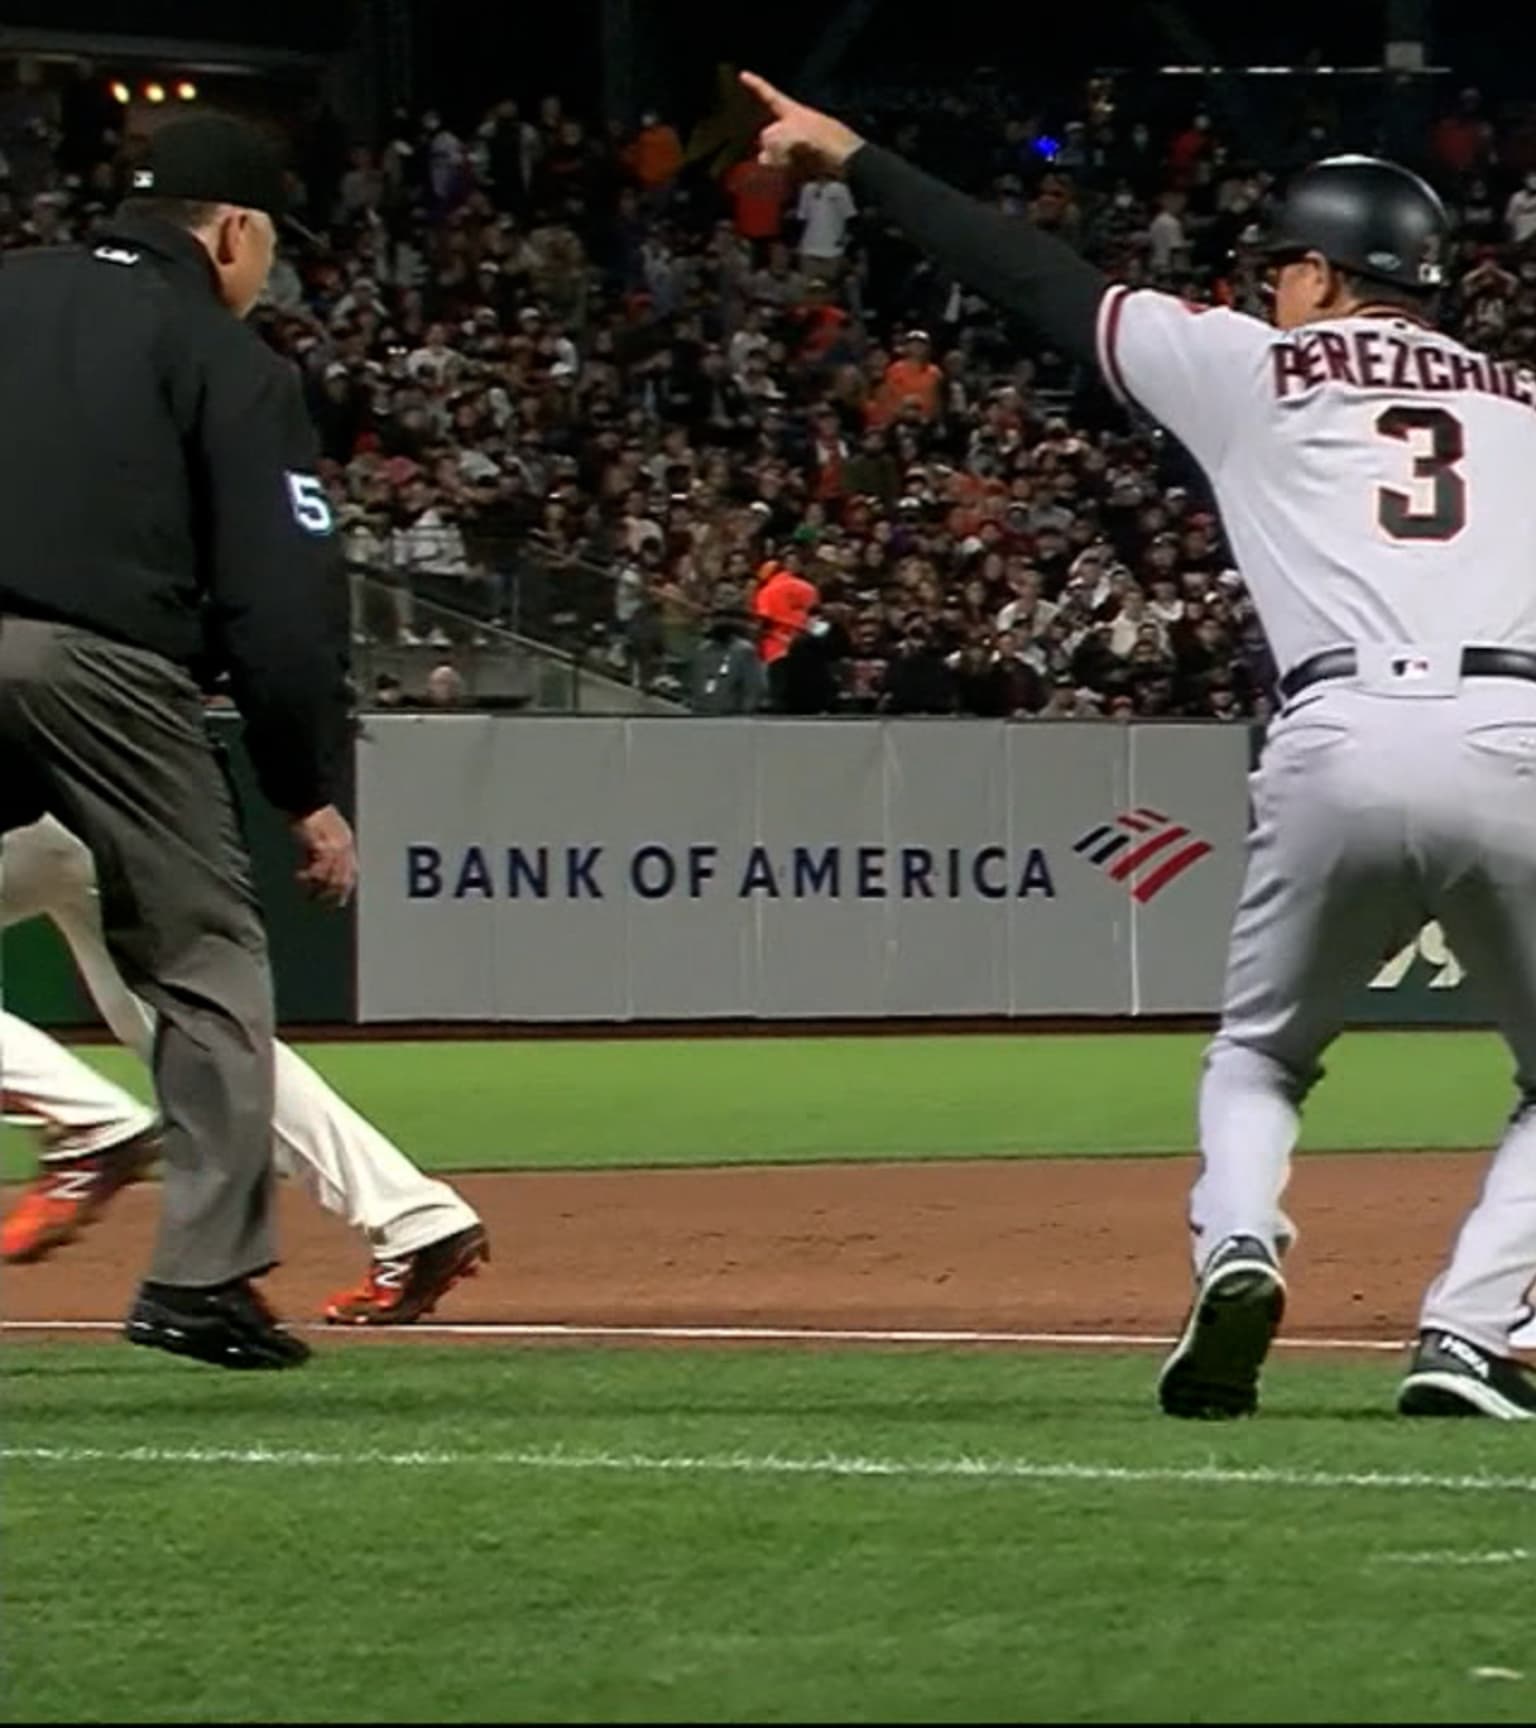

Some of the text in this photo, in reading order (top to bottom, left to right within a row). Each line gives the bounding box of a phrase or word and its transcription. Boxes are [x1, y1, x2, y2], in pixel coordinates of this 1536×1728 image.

[1375, 403, 1467, 543] 3
[406, 845, 1057, 899] BANK OF AMERICA
